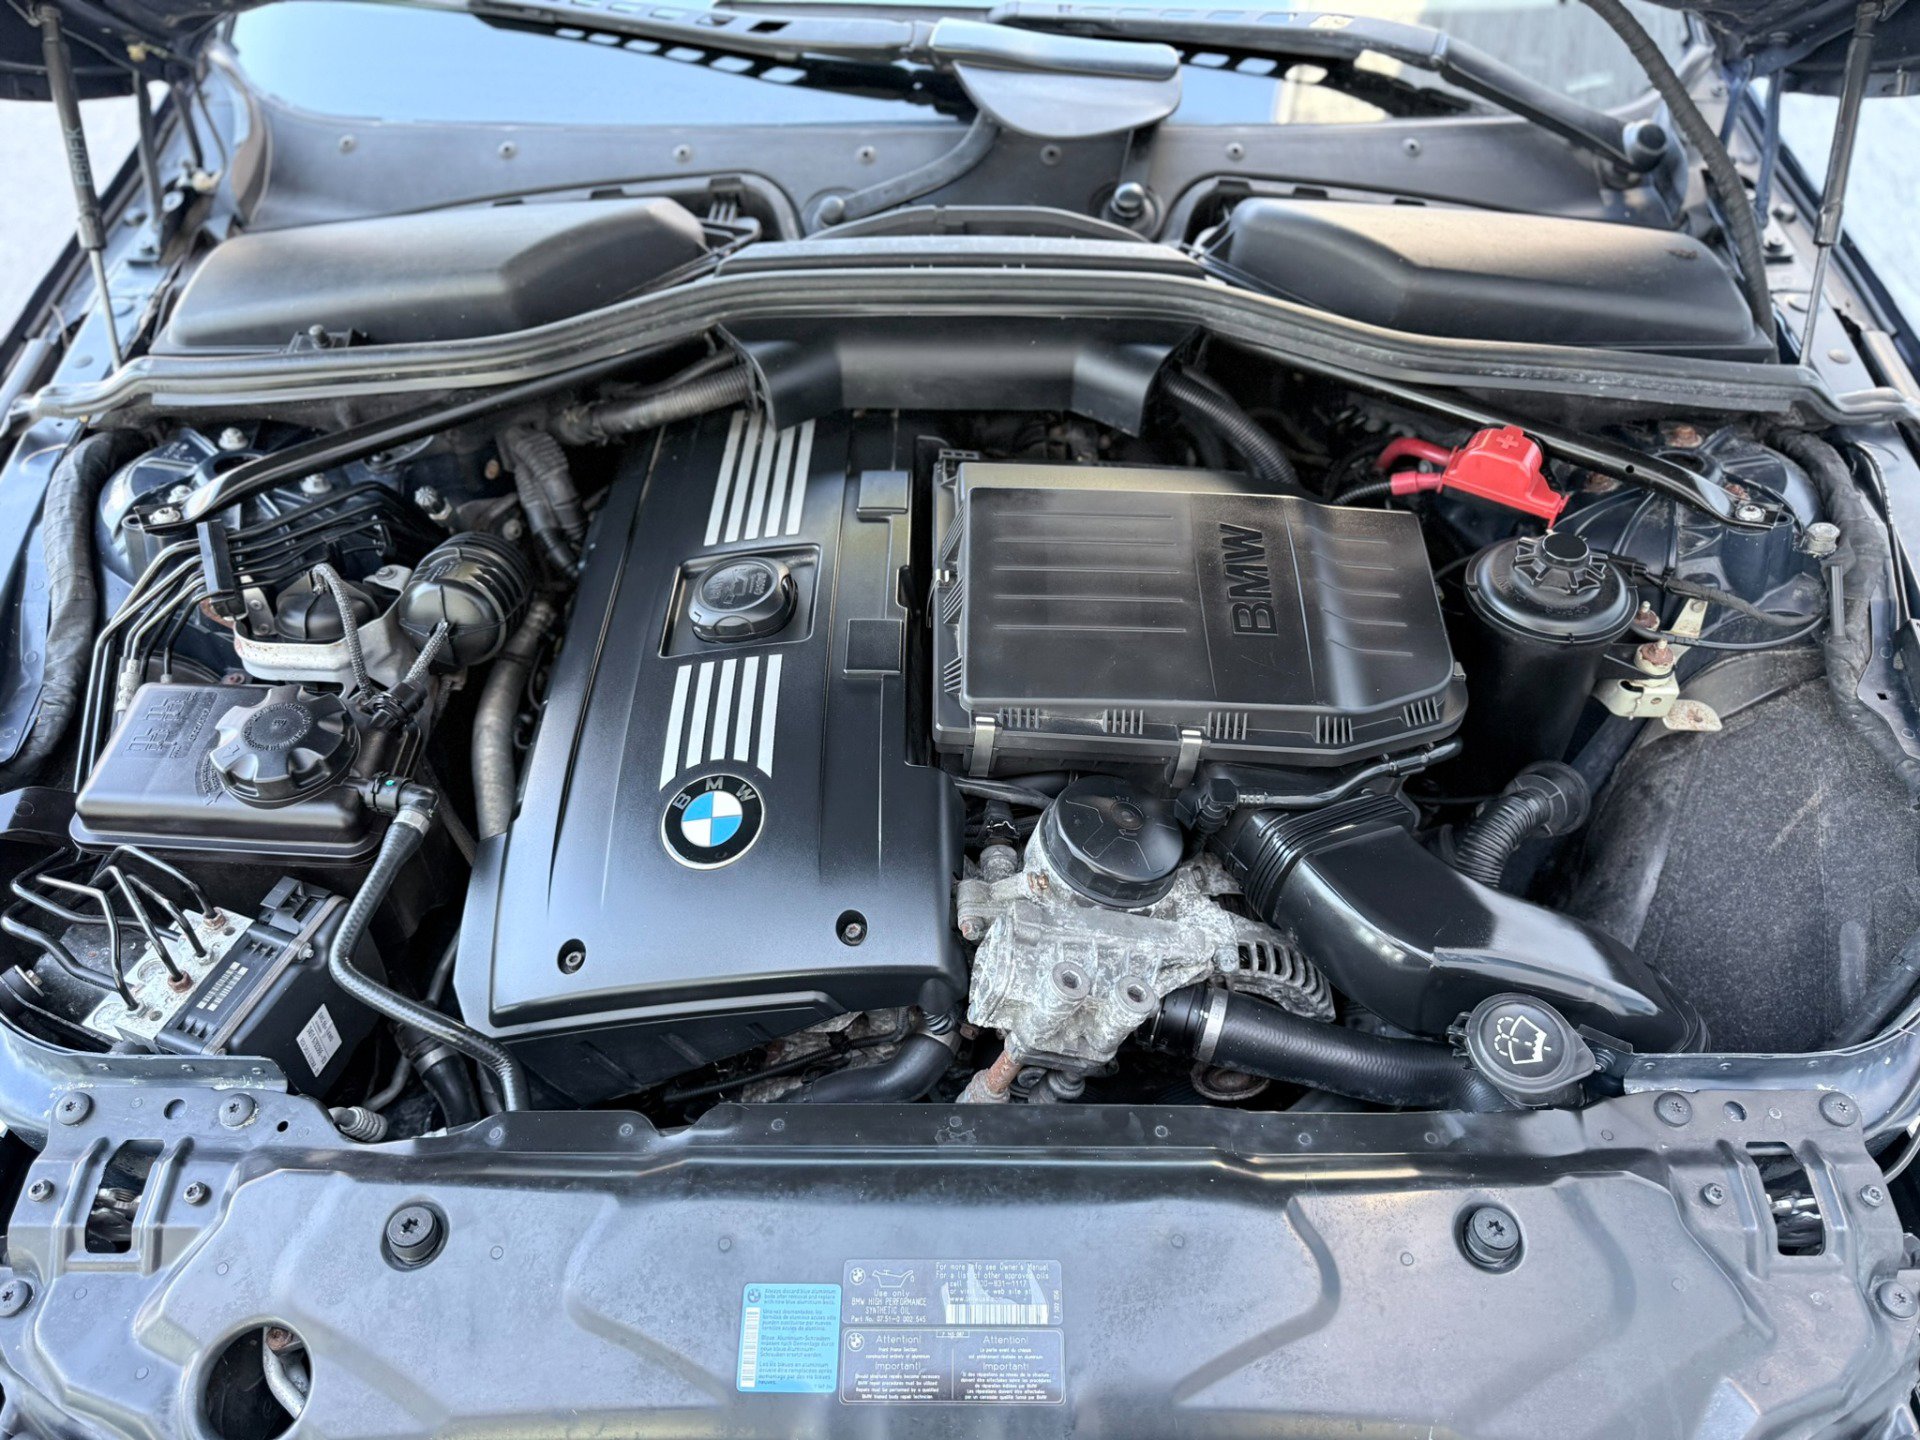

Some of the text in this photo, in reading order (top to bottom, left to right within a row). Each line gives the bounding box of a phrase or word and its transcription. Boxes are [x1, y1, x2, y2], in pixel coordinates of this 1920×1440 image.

[1219, 521, 1279, 636] BMW
[672, 776, 757, 811] BMW
[936, 1263, 947, 1271] For
[985, 1263, 997, 1271] see
[999, 1262, 1024, 1271] Owner's
[1026, 1263, 1049, 1271] Manual
[874, 1289, 910, 1297] Use only
[851, 1297, 927, 1306] BMW HIGH PERFORMANCE
[865, 1306, 911, 1315] SYNTHETIC OIL
[850, 1315, 863, 1323] Part
[875, 1335, 922, 1344] Attention!
[983, 1336, 1029, 1344] Attention!
[875, 1362, 921, 1372] Important!
[983, 1362, 1029, 1372] Important!
